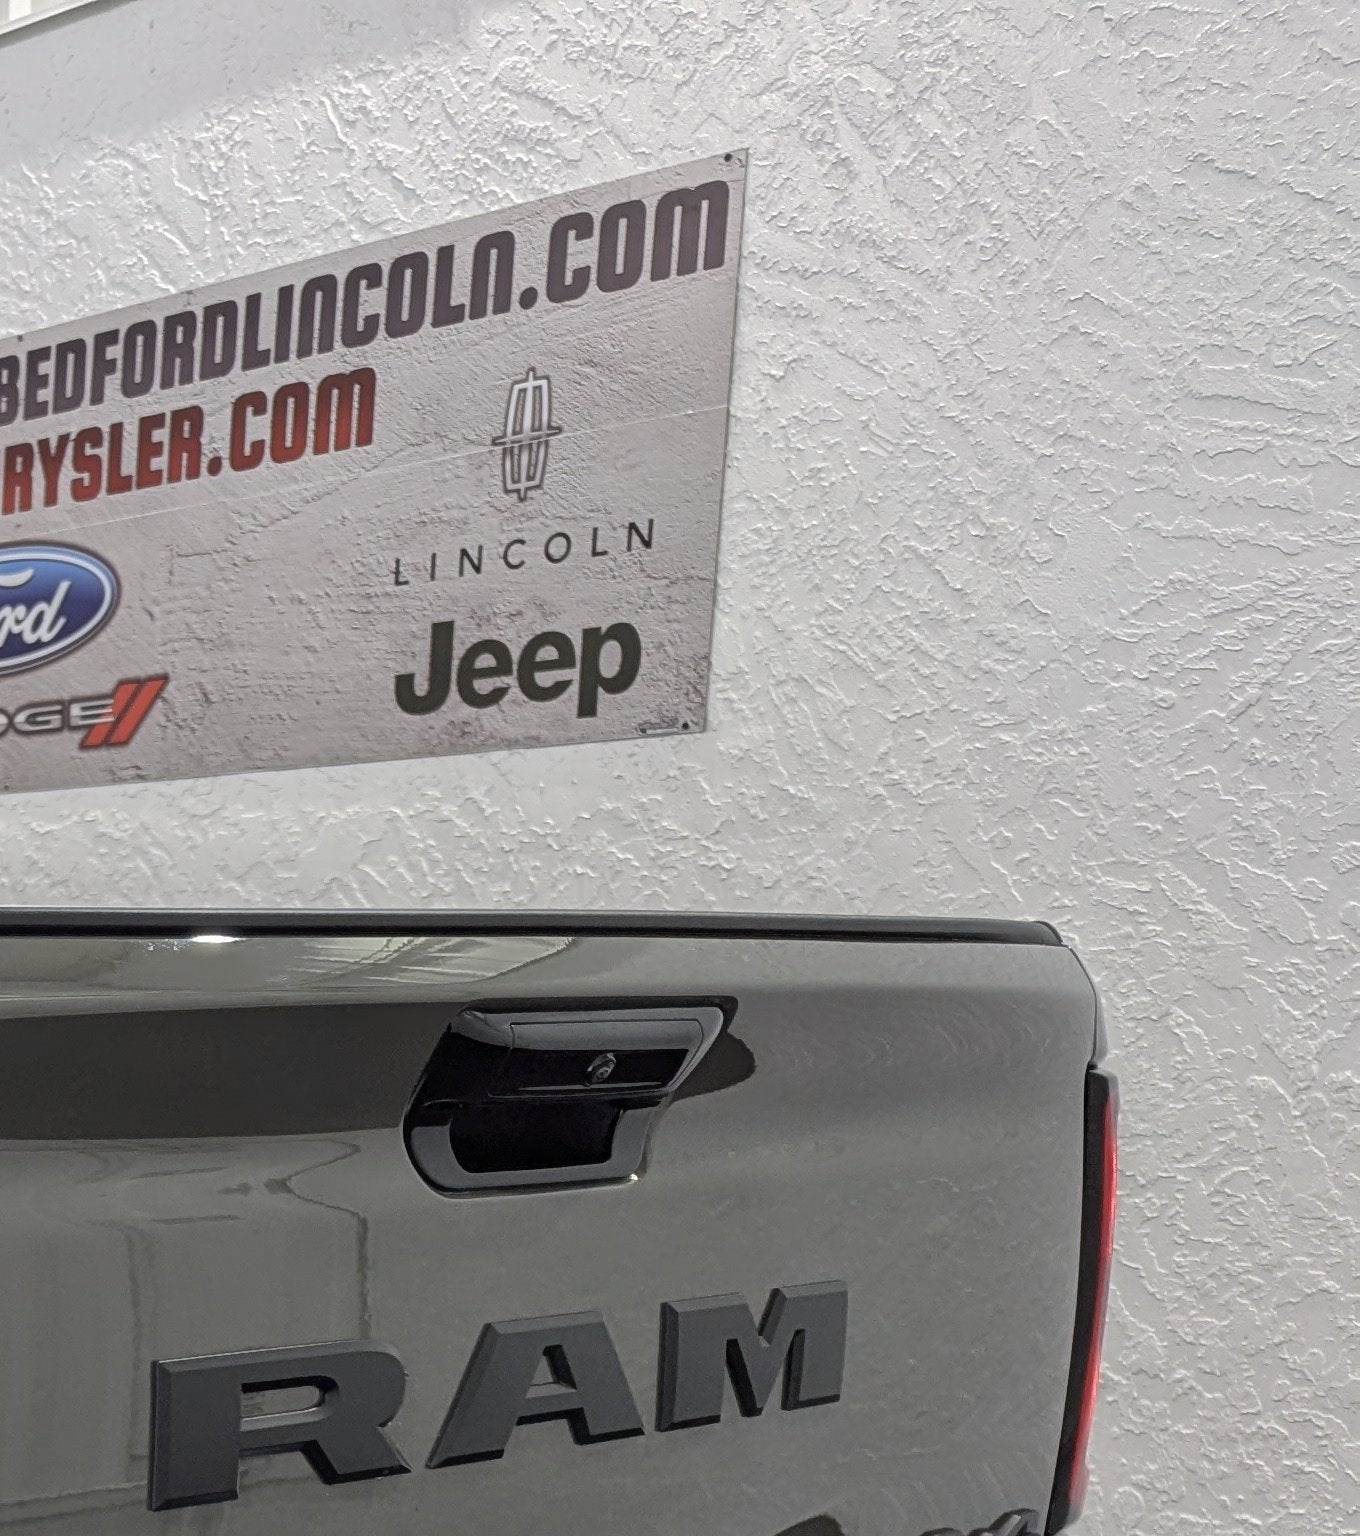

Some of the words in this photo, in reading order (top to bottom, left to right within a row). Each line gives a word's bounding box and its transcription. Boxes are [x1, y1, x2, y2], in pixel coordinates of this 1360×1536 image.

[394, 517, 654, 586] LINCOLN
[393, 620, 642, 719] Jeep
[147, 1279, 849, 1512] RAM
